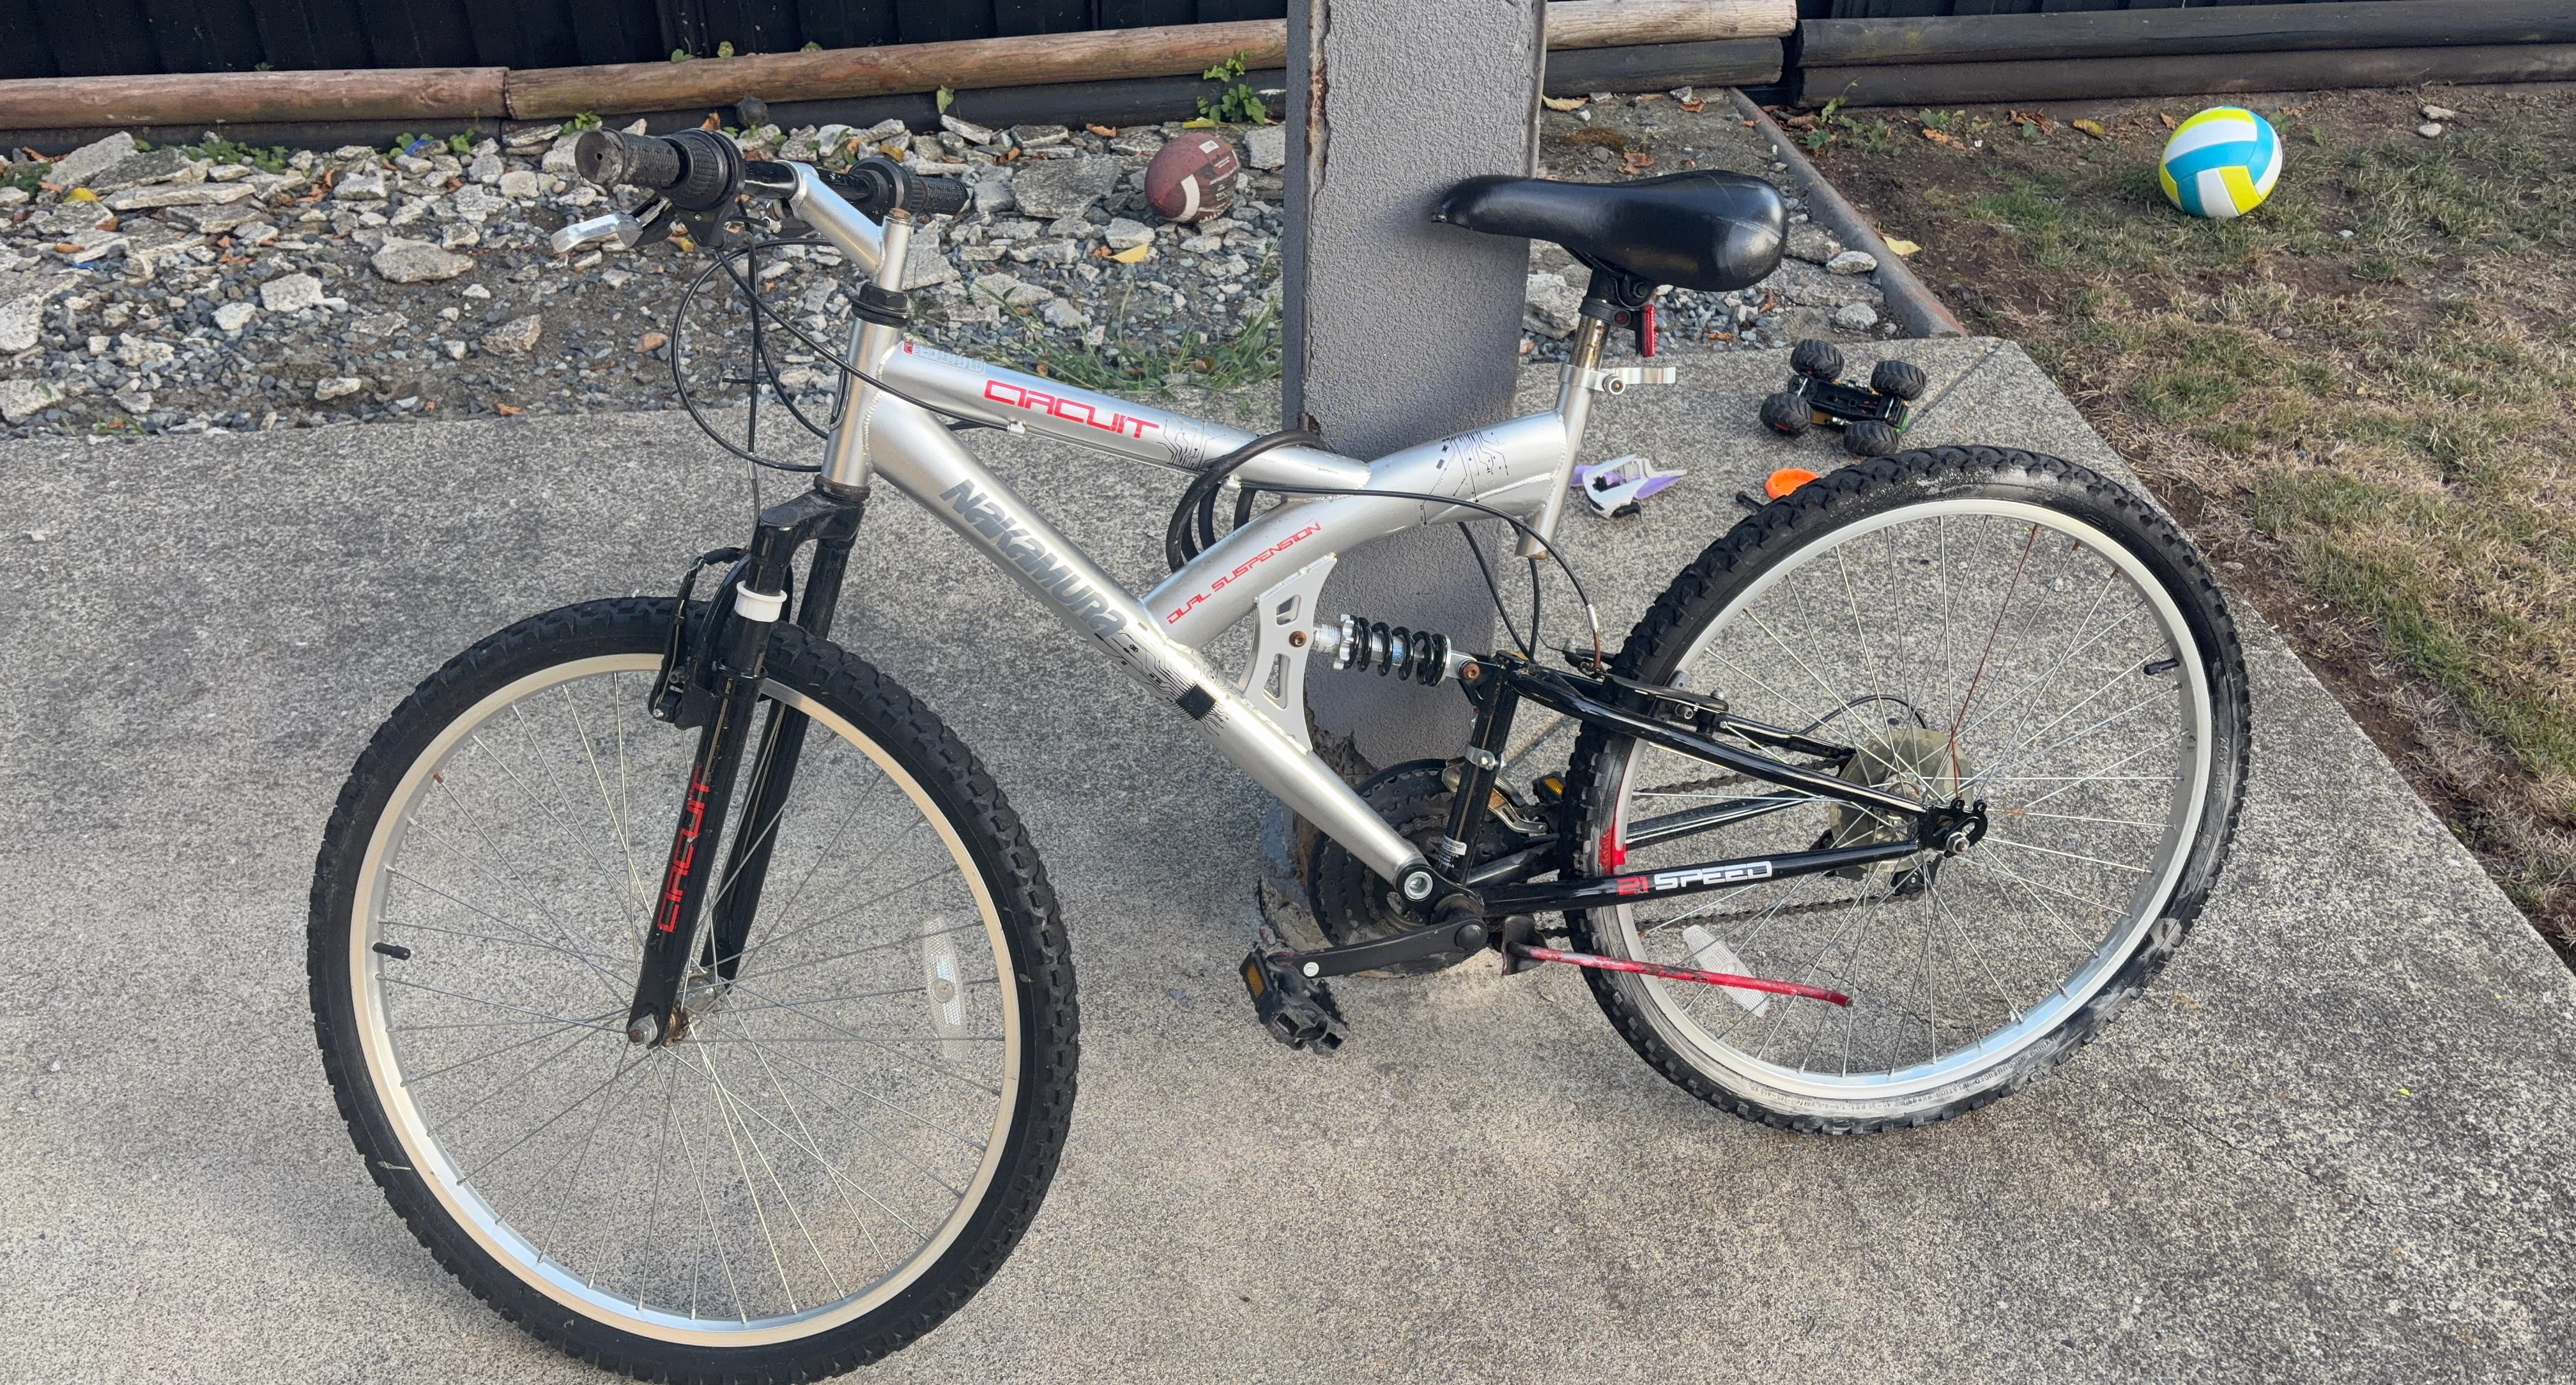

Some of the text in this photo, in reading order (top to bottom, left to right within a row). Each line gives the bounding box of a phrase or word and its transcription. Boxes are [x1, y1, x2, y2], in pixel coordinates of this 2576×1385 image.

[984, 380, 1160, 439] CIRCUIT
[1167, 523, 1322, 625] DUAL SUSPENSION
[657, 764, 710, 933] CIRCUIT
[1615, 861, 1772, 896] 21 SPEED
